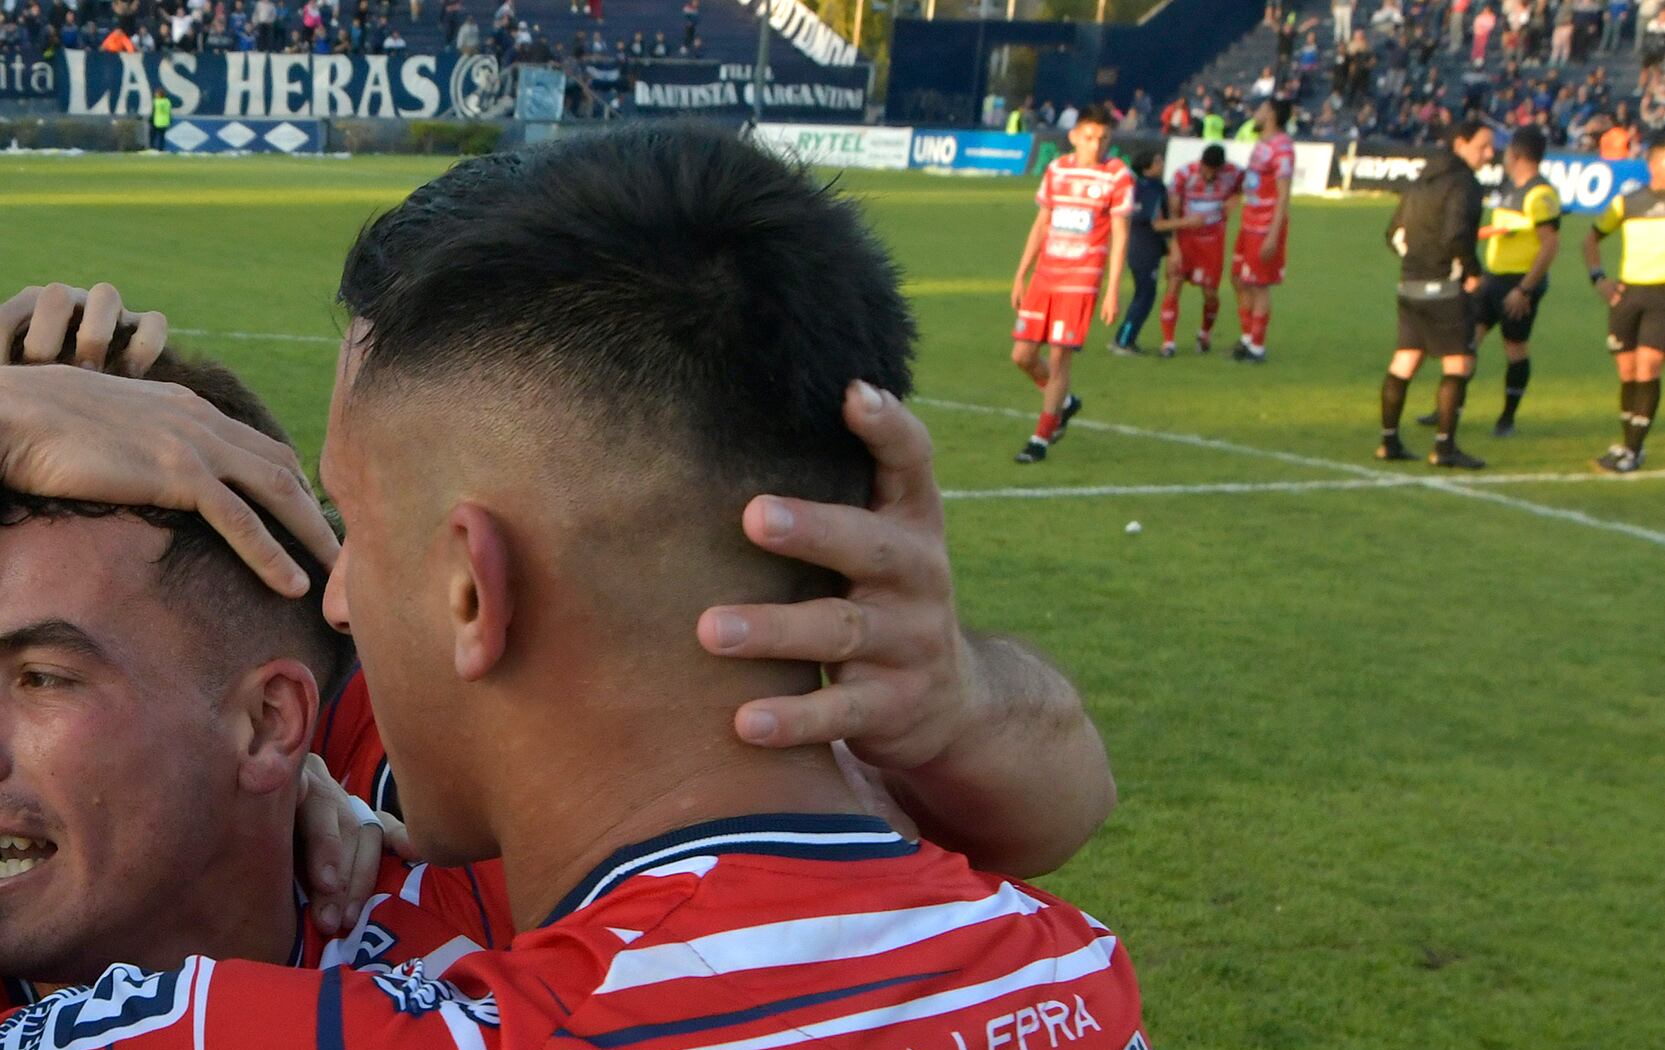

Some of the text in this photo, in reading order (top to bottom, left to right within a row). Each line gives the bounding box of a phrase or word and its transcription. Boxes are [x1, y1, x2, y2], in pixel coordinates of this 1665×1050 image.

[64, 48, 441, 119] LAS HERAS
[913, 135, 957, 165] UNO
